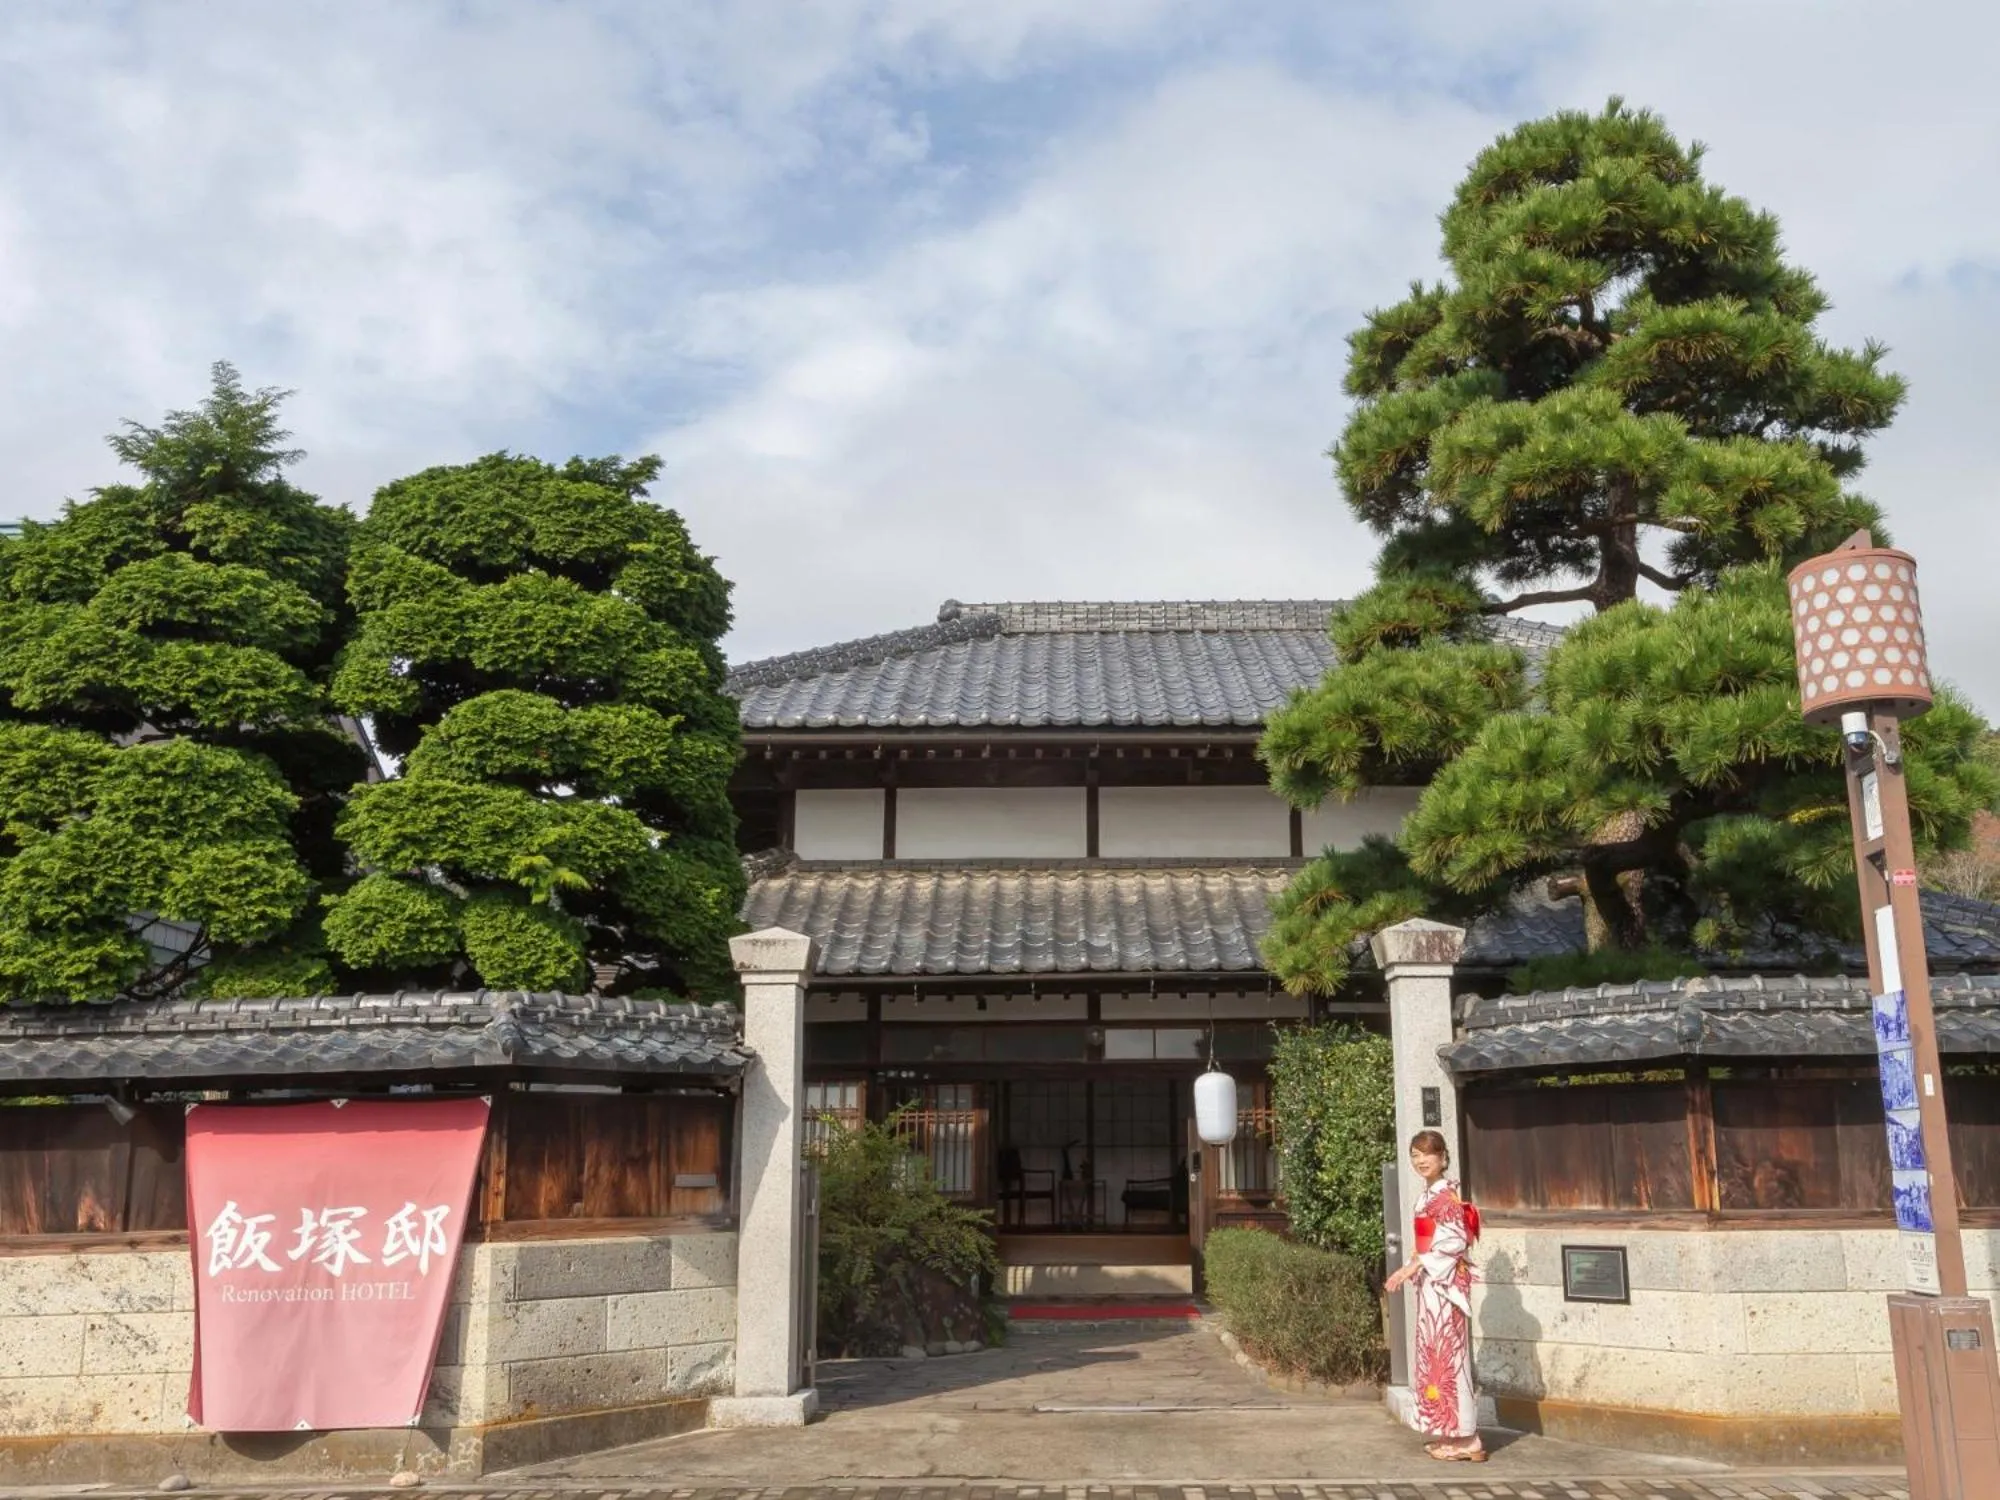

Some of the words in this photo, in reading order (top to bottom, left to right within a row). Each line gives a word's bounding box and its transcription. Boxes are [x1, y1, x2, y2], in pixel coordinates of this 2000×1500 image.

[206, 1201, 450, 1277] 飯塚邸
[222, 1284, 333, 1304] Renovation
[341, 1282, 415, 1302] HOTEL
